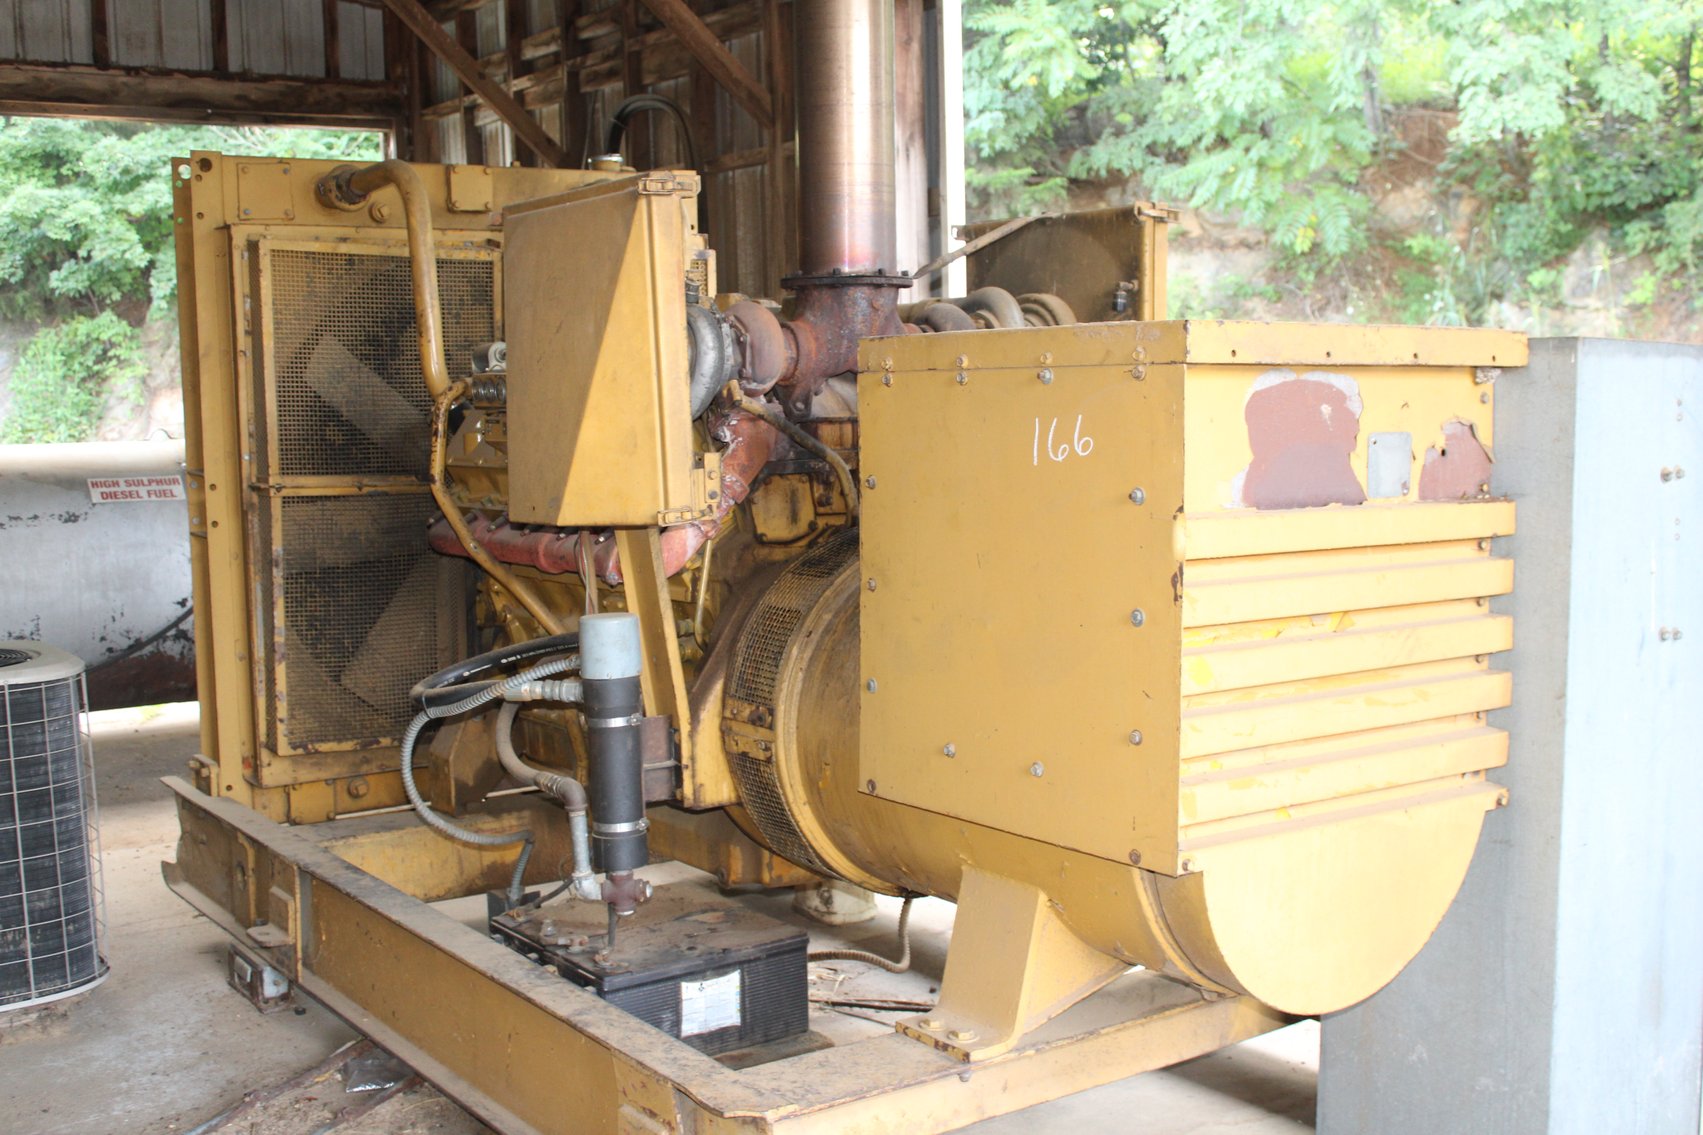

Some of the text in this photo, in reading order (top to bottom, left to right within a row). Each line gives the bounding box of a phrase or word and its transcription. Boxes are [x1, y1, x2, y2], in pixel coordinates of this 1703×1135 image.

[1033, 414, 1094, 466] 166
[90, 477, 181, 489] HIGH SULPHUR
[100, 489, 177, 500] DIESEL FUEL
